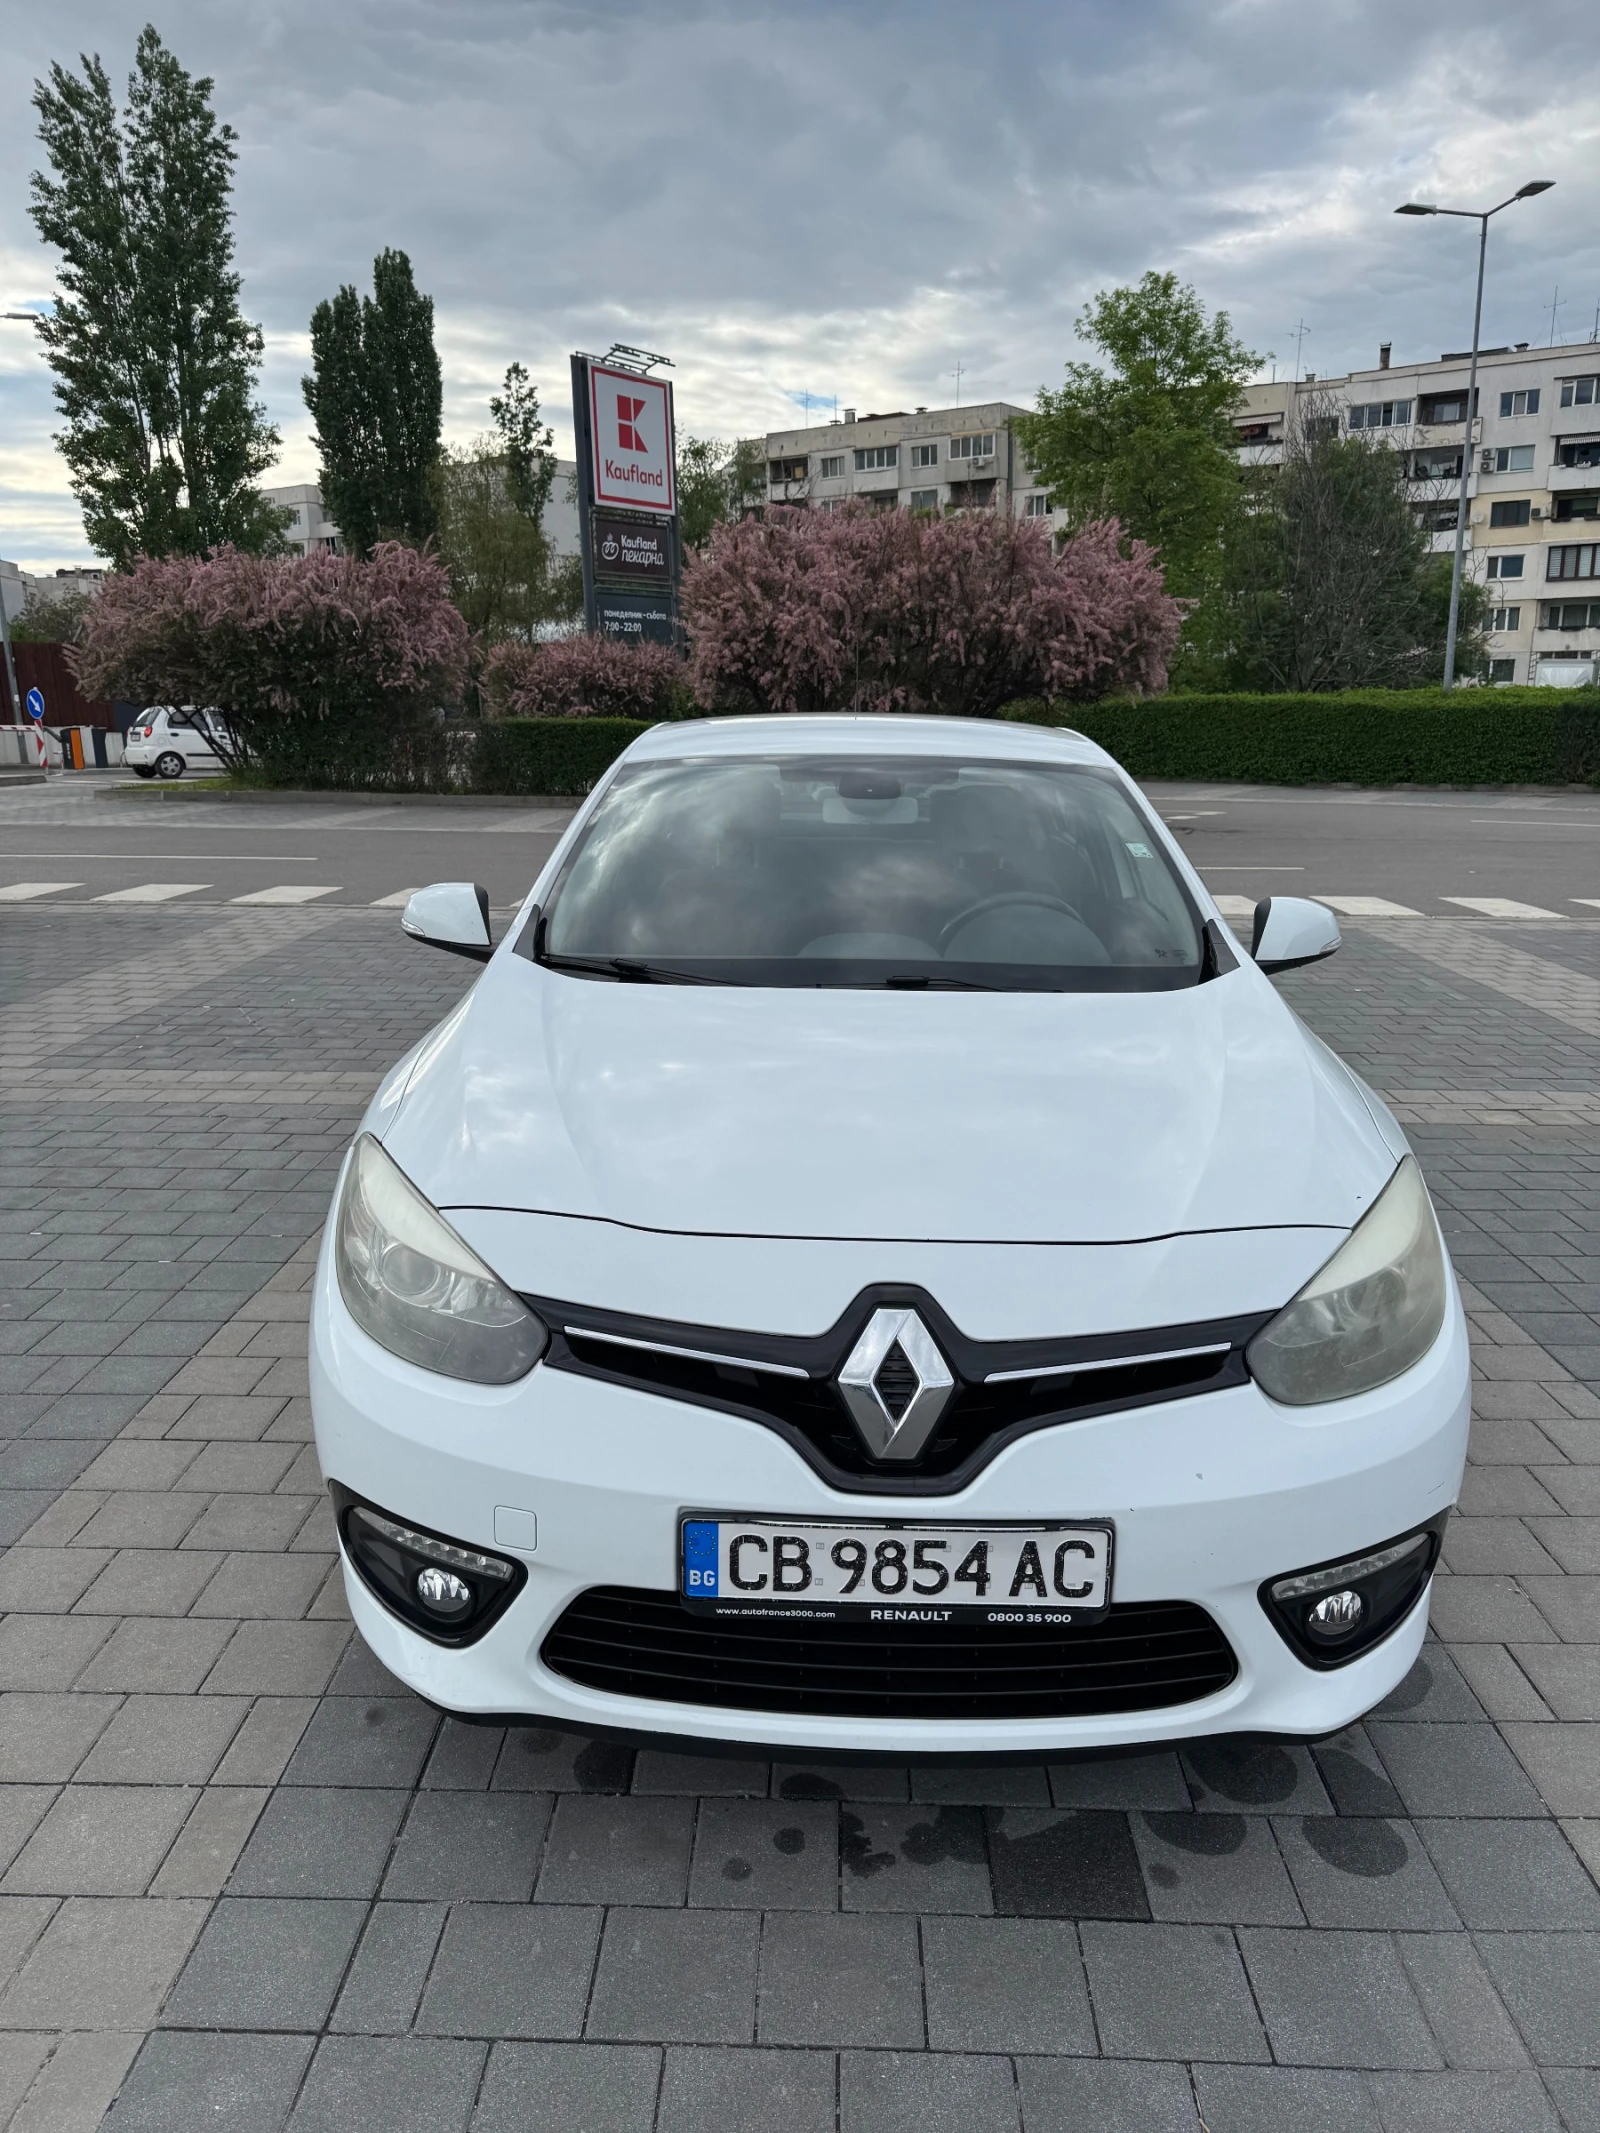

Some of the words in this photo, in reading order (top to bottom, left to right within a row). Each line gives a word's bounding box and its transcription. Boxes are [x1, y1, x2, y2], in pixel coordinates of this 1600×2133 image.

[605, 459, 663, 487] Kaufland
[621, 534, 657, 551] Kaufland
[621, 549, 664, 567] пекарна
[729, 1534, 812, 1592] CB
[831, 1538, 991, 1596] 9854
[1009, 1539, 1095, 1598] AC
[689, 1569, 715, 1587] BG
[716, 1608, 836, 1618] www.autofrance3000.com
[870, 1610, 952, 1621] RENAULT
[988, 1613, 1024, 1622] 0800
[1026, 1613, 1042, 1622] 35
[1044, 1614, 1071, 1623] 900
